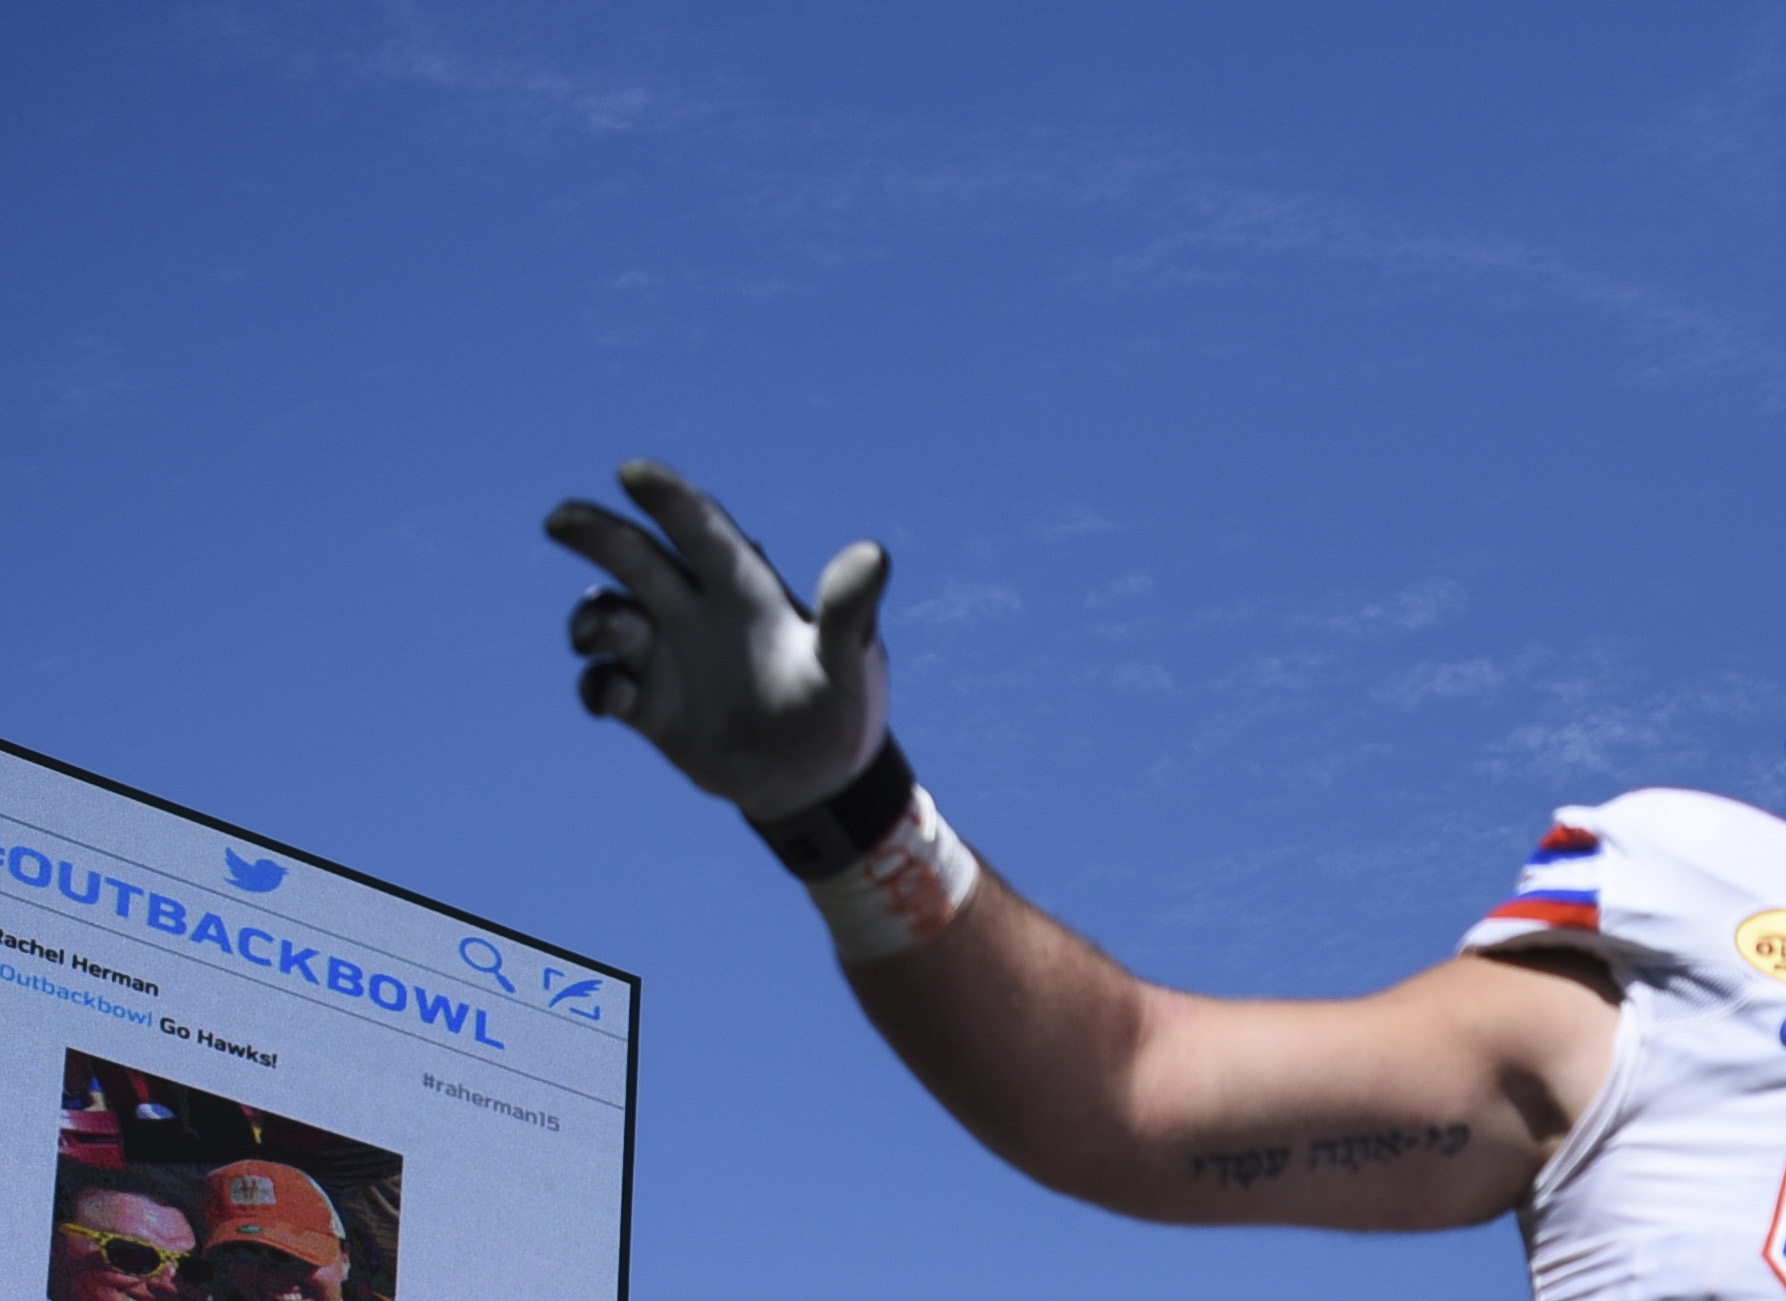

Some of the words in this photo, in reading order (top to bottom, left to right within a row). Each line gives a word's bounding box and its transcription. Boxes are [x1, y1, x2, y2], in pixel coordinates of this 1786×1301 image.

[71, 953, 159, 997] Herman
[159, 1016, 190, 1040] Go
[197, 1028, 278, 1069] Hawks!
[422, 1072, 561, 1133] #raherman15
